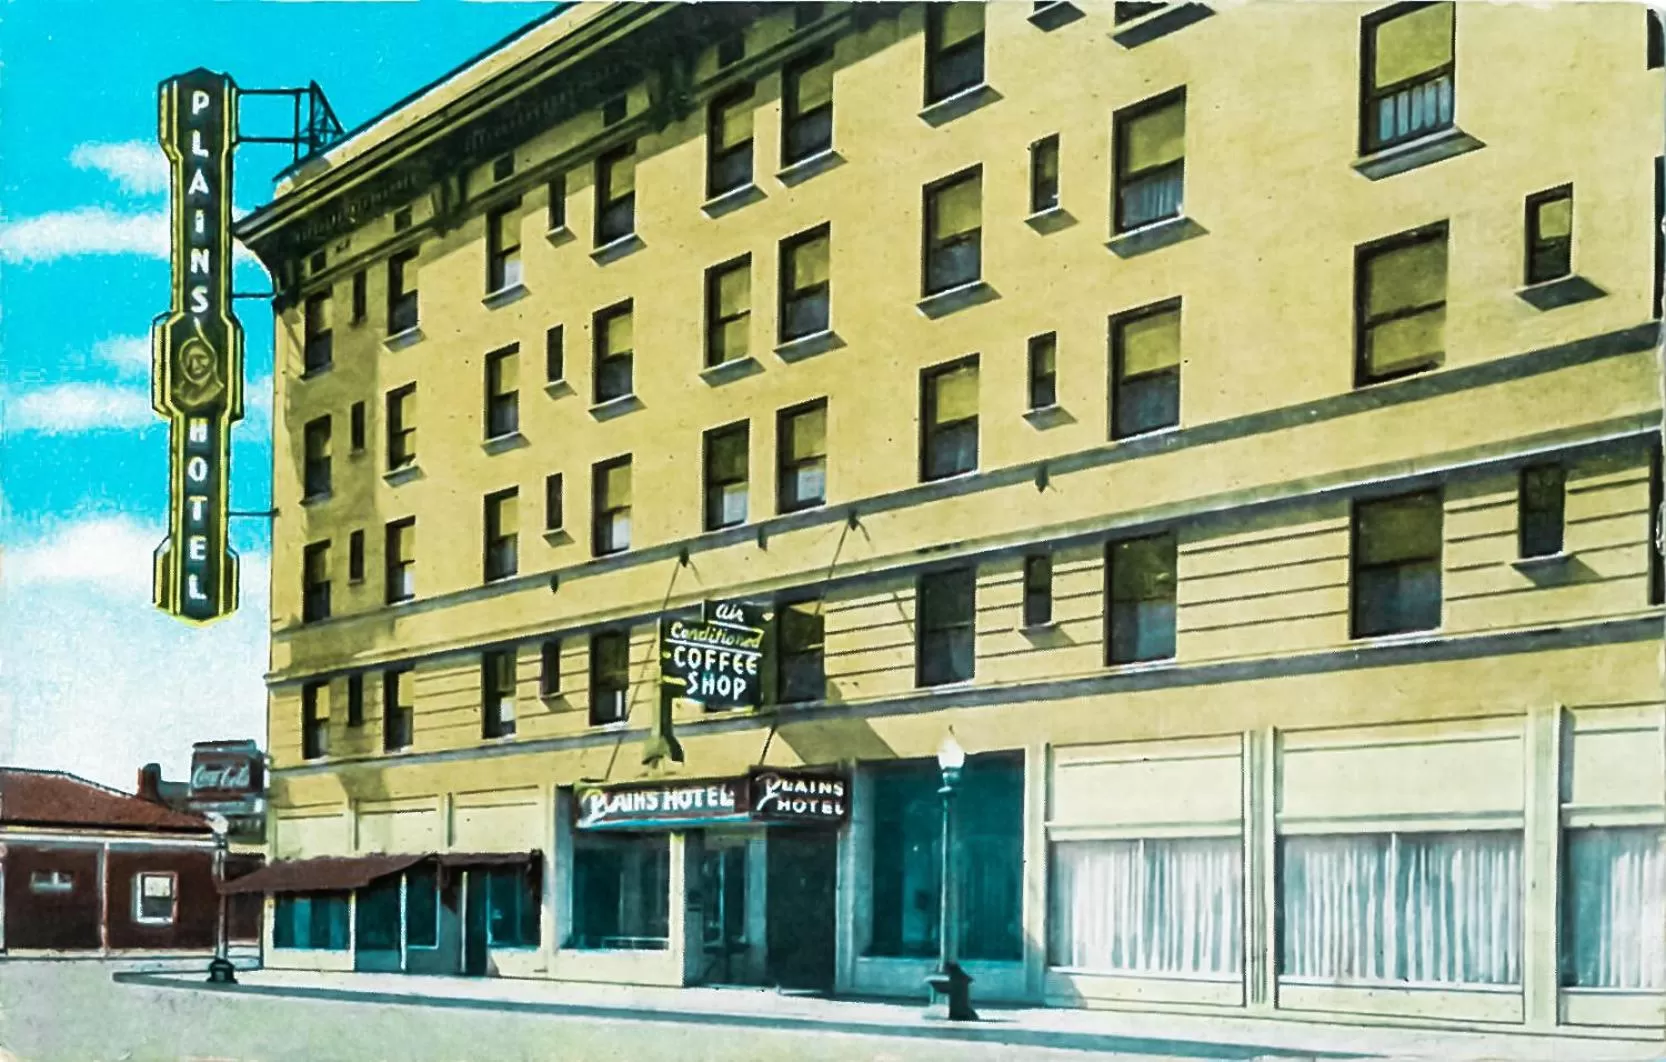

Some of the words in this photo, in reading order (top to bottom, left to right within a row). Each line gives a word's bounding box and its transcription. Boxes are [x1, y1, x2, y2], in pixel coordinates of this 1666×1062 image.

[187, 89, 210, 314] PLAINS
[187, 417, 208, 600] HOTEL
[673, 646, 758, 675] COFFEE
[686, 671, 747, 701] SHOP
[662, 783, 735, 812] HOTEL
[755, 772, 844, 811] PLAINS
[776, 797, 845, 815] HOTEL
